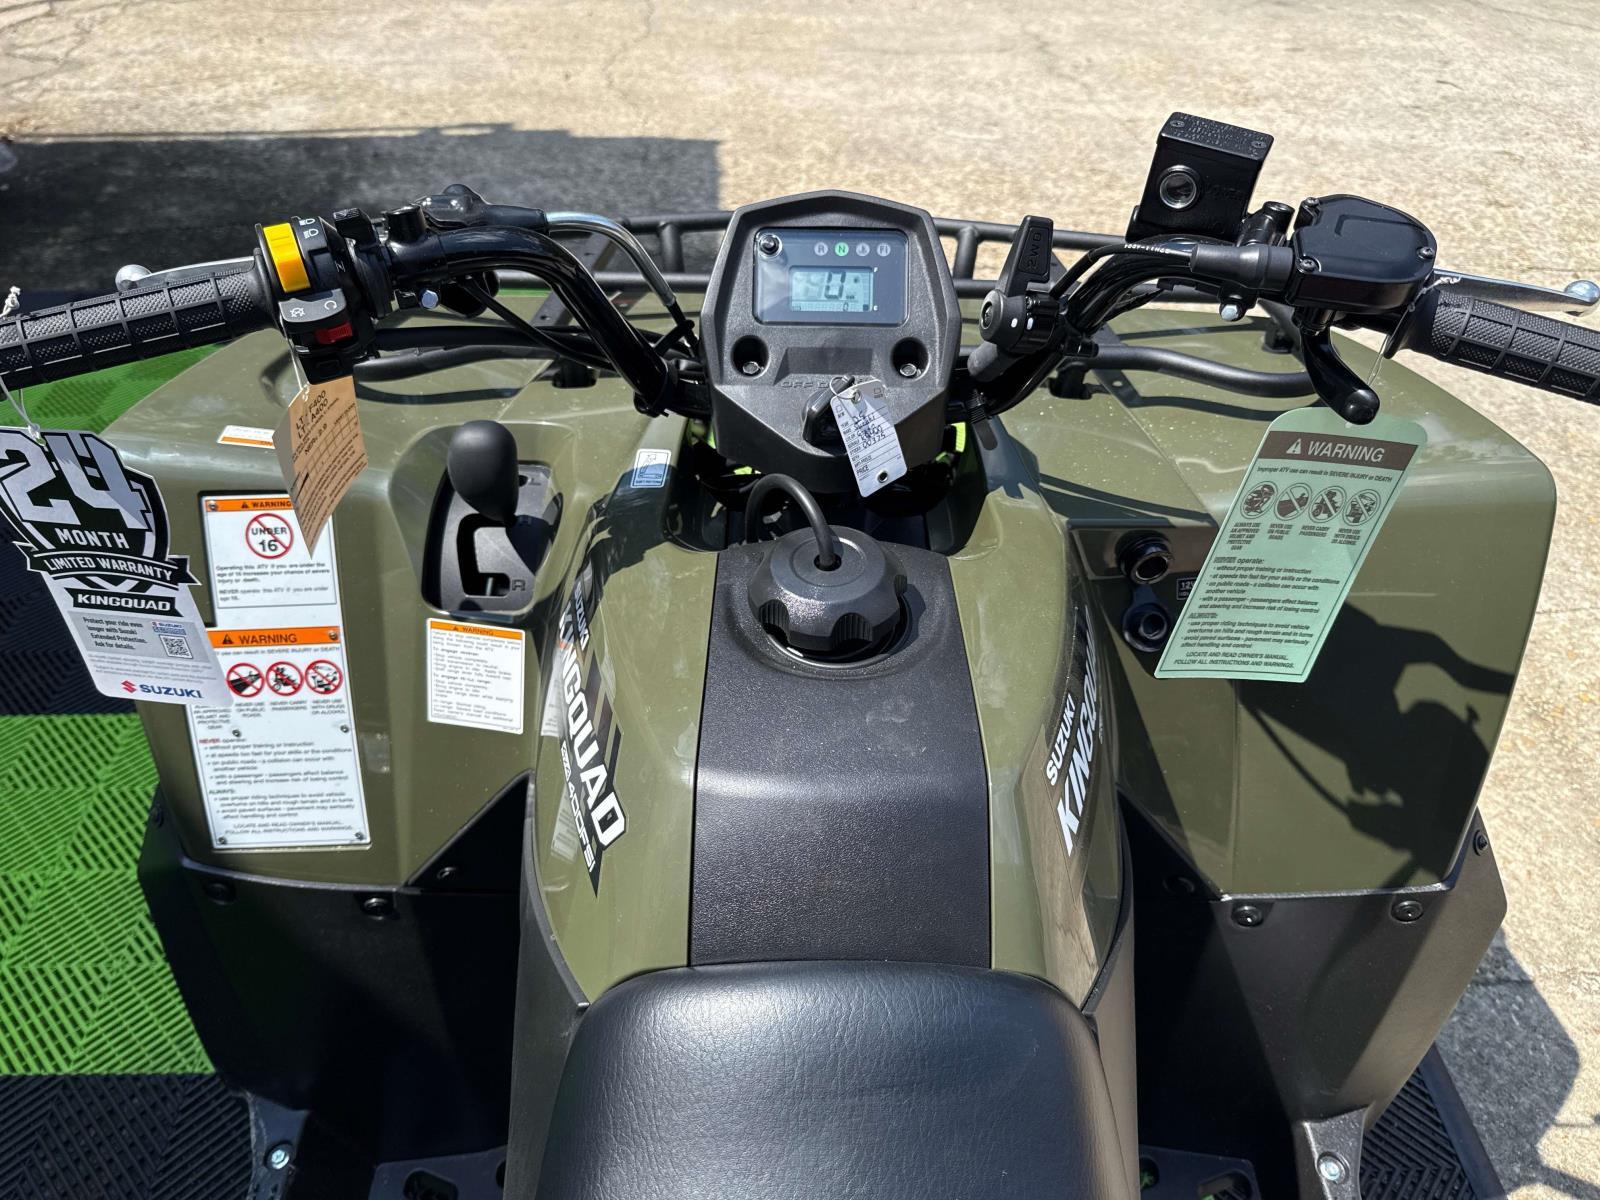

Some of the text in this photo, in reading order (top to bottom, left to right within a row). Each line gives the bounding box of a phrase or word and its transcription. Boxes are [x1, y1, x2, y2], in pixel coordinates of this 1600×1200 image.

[838, 244, 846, 254] N
[824, 270, 846, 300] 0
[1307, 440, 1385, 463] WARNING
[0, 432, 148, 530] 24
[251, 500, 292, 508] WARNING
[54, 528, 130, 549] MONTH
[251, 526, 288, 536] UNDER
[258, 539, 278, 553] 16
[43, 557, 173, 581] LIMITED WARRANTY
[511, 579, 526, 591] R
[77, 593, 171, 611] KINGQUAD
[574, 580, 591, 651] SUZUKI
[238, 633, 298, 645] WARNING
[138, 684, 204, 699] SUZUKI
[559, 603, 626, 846] KINGQUAD
[1046, 694, 1076, 786] SUZUKI
